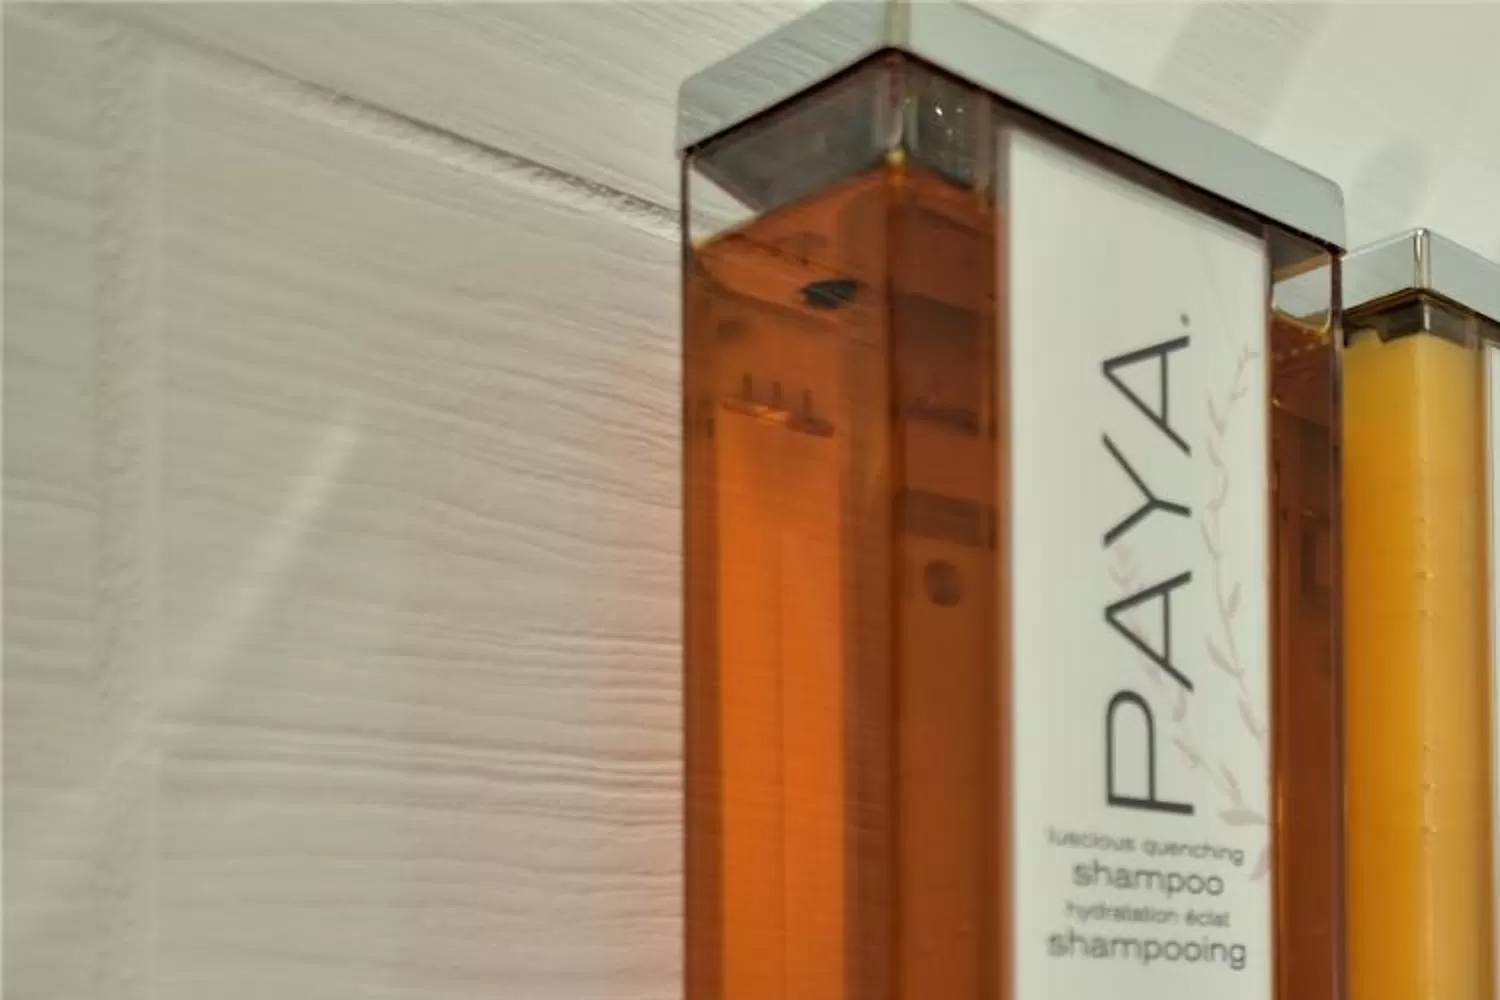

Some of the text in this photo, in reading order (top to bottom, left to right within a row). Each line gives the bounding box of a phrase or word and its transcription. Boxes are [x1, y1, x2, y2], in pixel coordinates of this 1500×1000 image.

[1100, 335, 1194, 816] PAYA
[1047, 825, 1245, 867] luscious quenching
[1072, 858, 1224, 899] shampoo
[1047, 928, 1247, 971] shampooing
